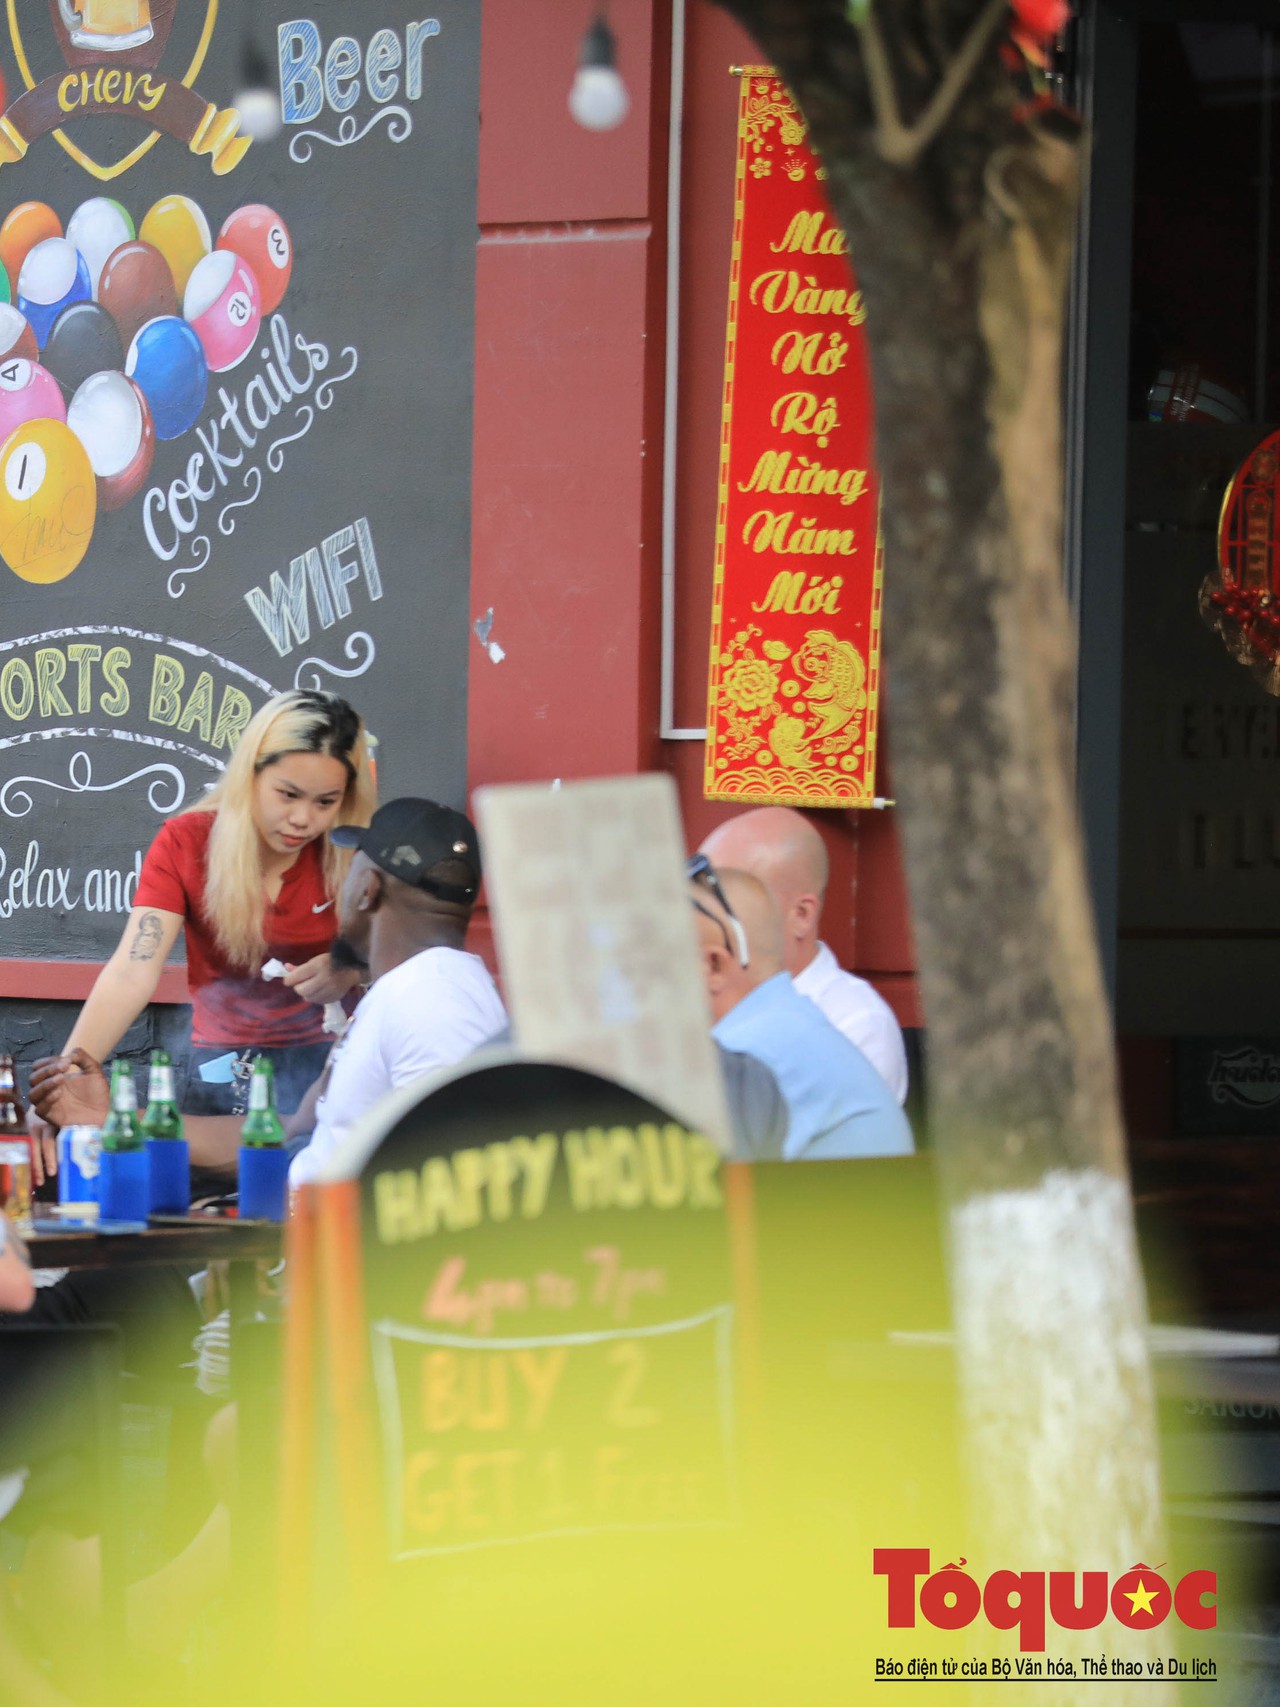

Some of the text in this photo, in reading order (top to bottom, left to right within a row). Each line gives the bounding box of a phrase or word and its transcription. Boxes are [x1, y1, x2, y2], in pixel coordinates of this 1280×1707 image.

[277, 18, 441, 125] Beer
[749, 271, 868, 326] Vàng
[771, 331, 848, 375] Nở
[143, 314, 330, 561] Cocktails
[771, 392, 841, 448] Rộ
[18, 454, 27, 490] 1
[738, 450, 869, 506] Mừng
[744, 511, 857, 556] Năm
[243, 516, 384, 657] WIFI
[752, 570, 844, 615] Mới
[148, 654, 252, 753] BAR
[85, 850, 142, 913] and
[373, 1122, 724, 1245] HAPPY HOUR
[424, 1342, 660, 1432] BUY 2
